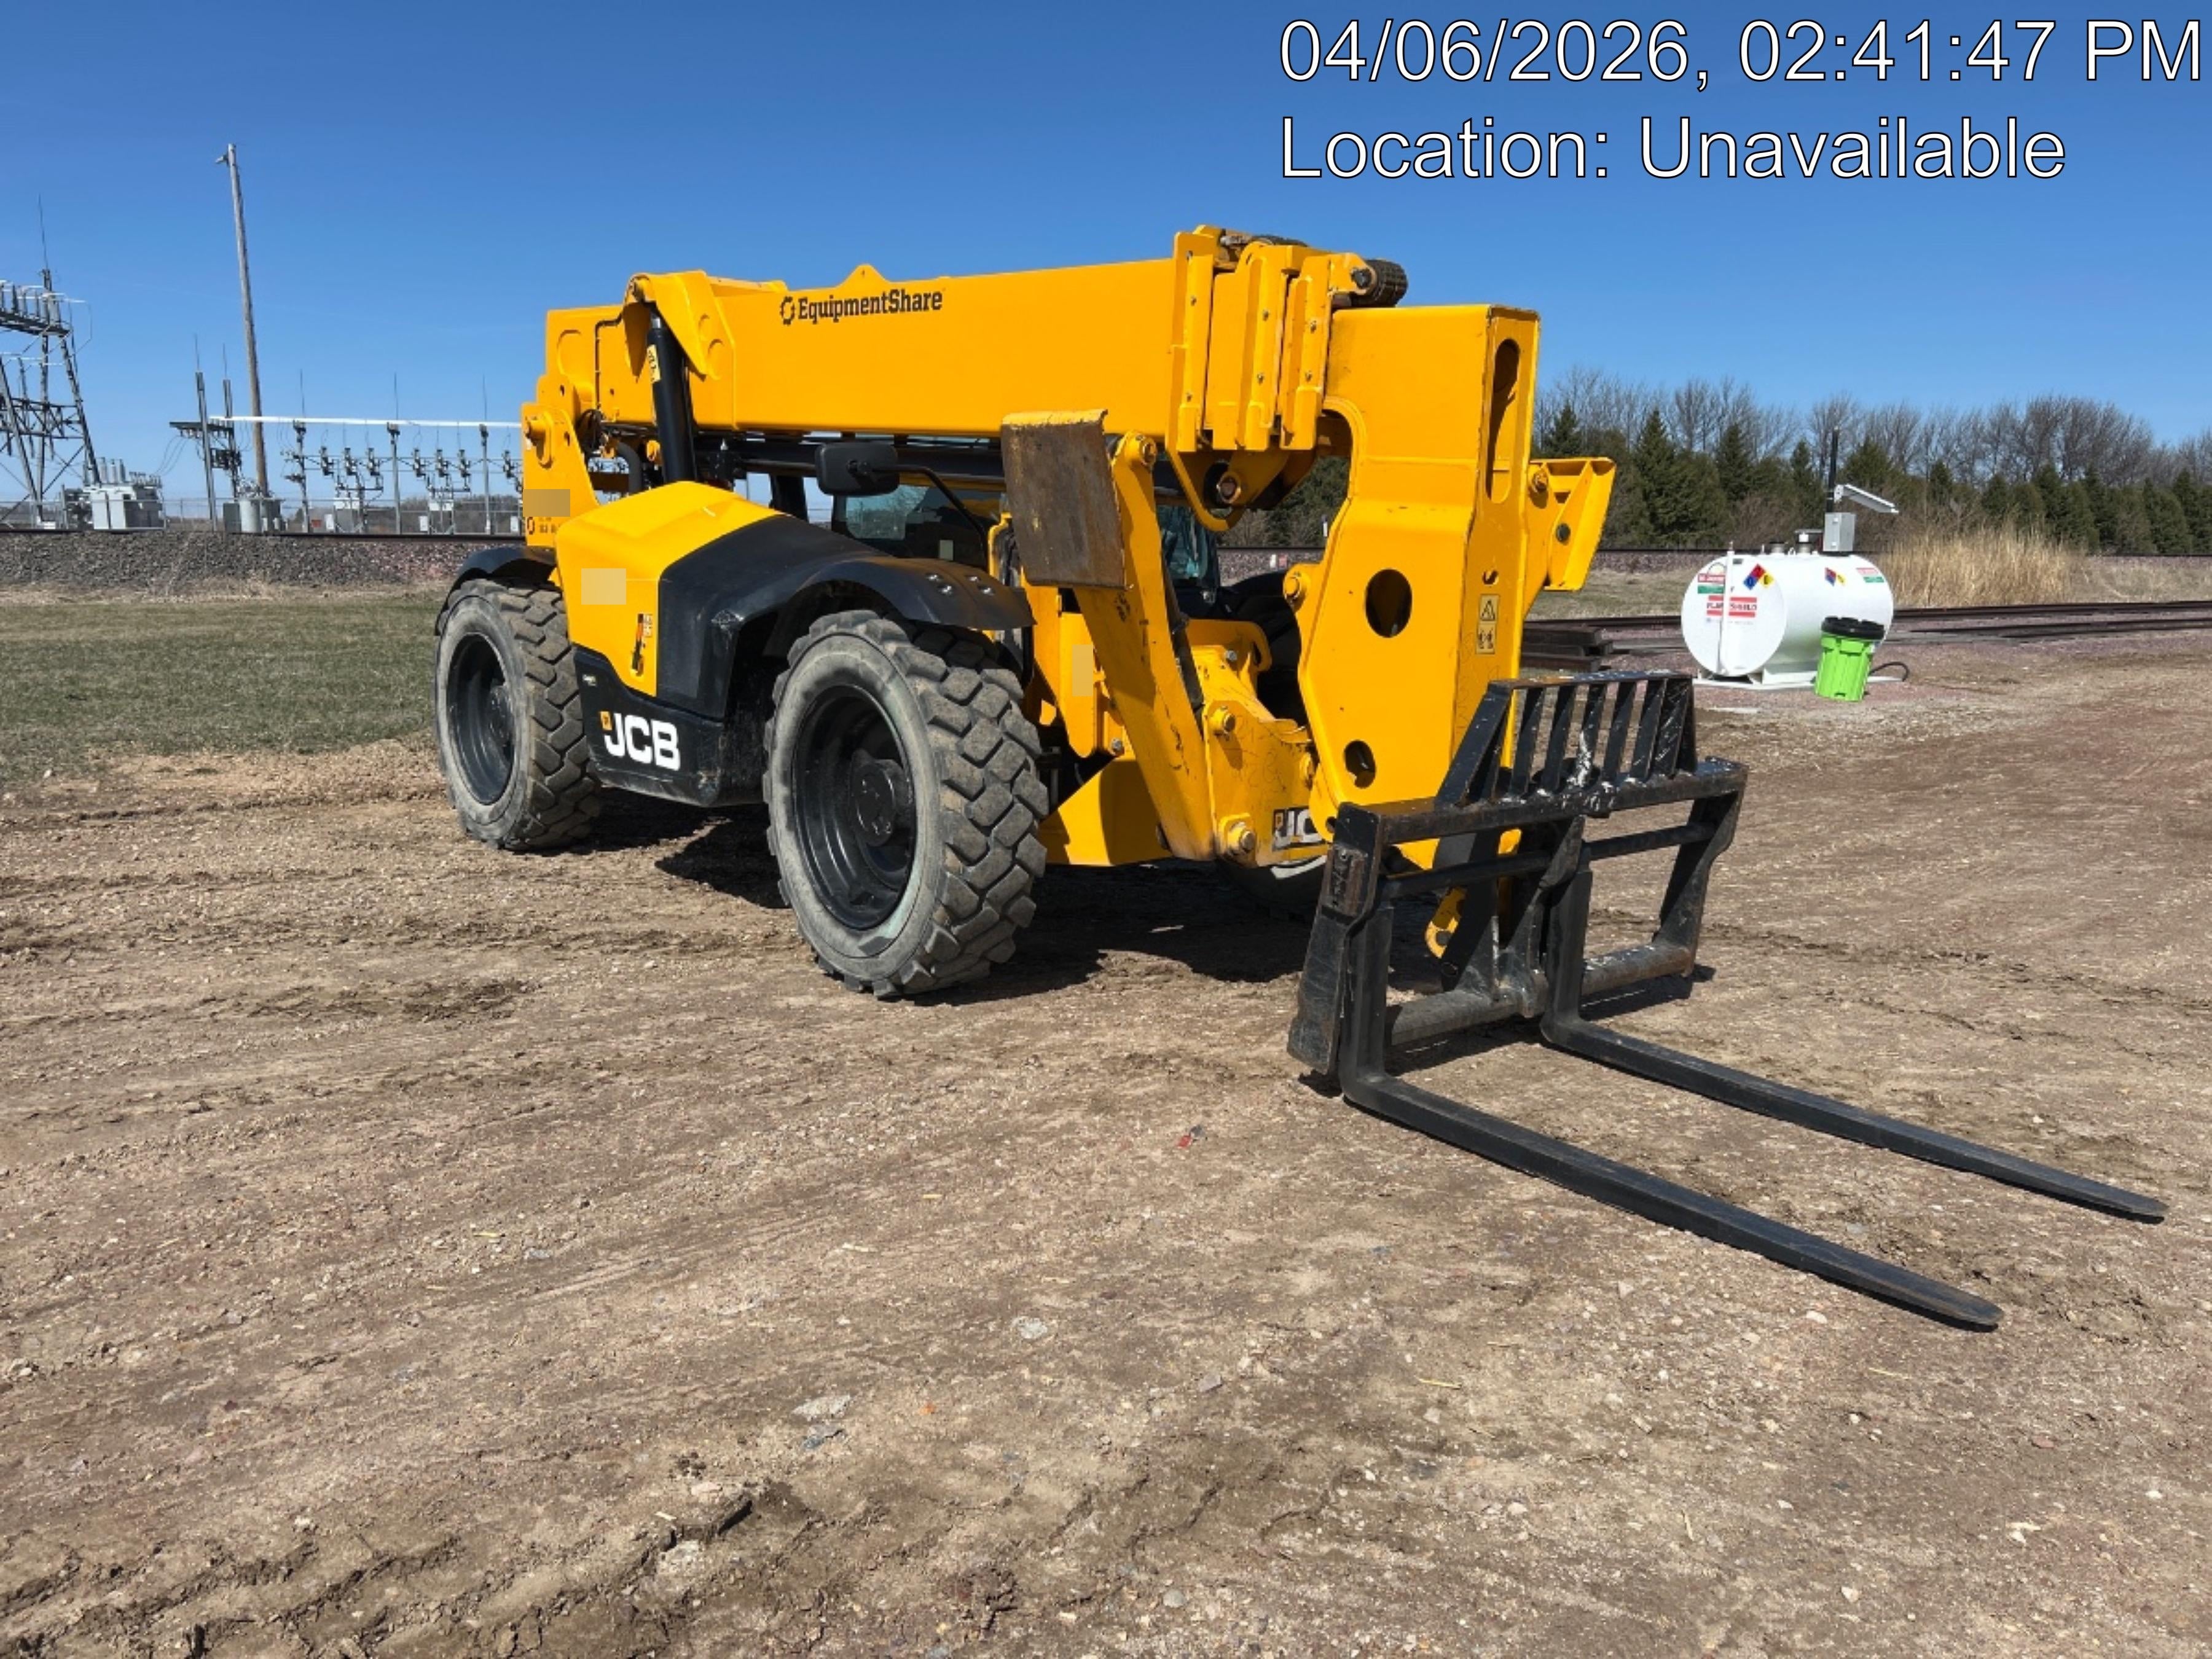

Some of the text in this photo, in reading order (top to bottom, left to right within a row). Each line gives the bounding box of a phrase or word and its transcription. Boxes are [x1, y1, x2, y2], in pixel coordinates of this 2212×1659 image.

[798, 289, 943, 324] EquipmentShare
[604, 713, 681, 771] JCB
[1274, 809, 1321, 847] JC
